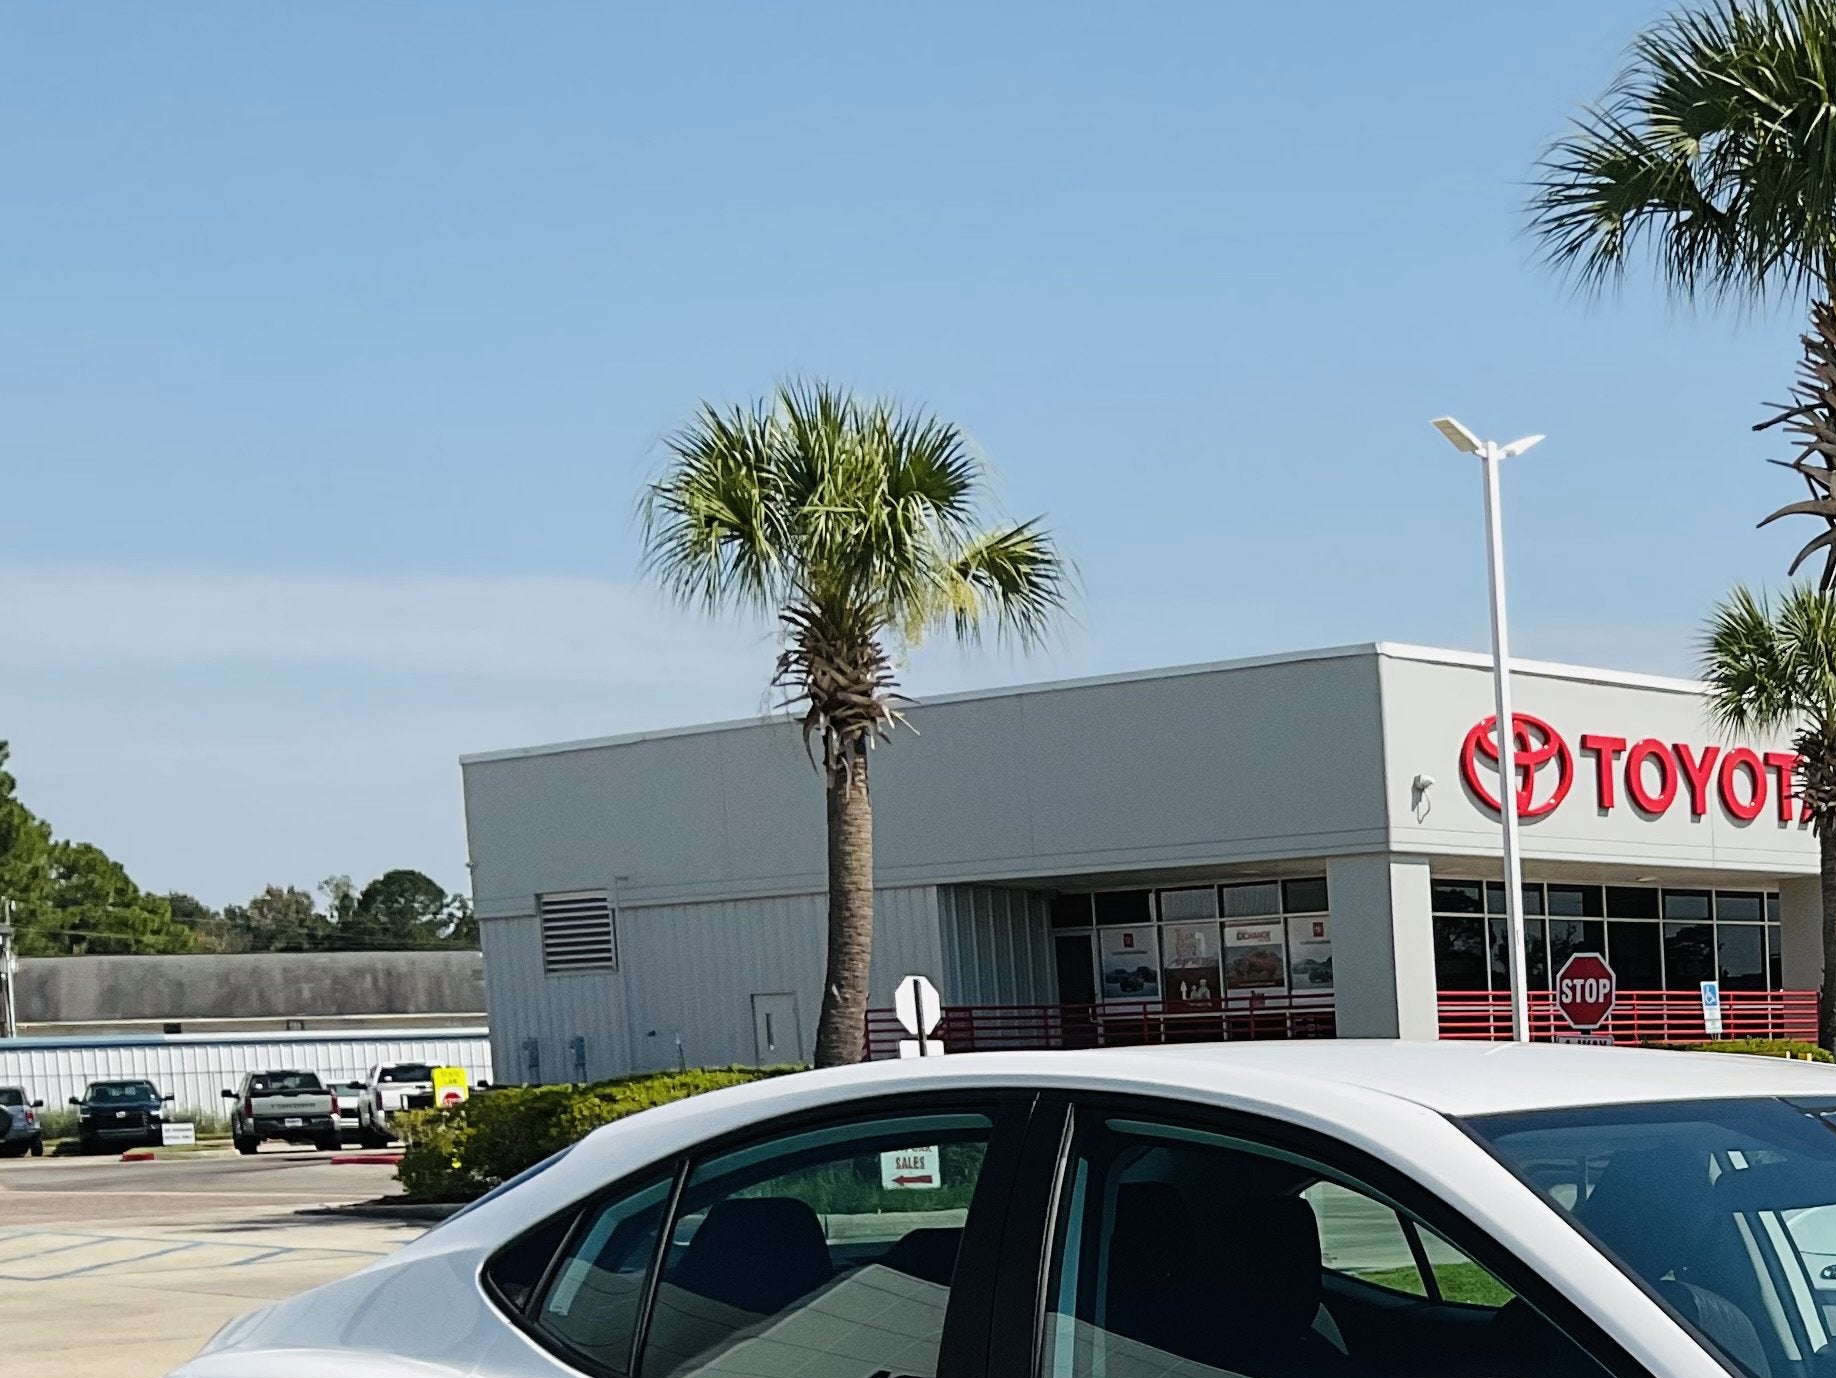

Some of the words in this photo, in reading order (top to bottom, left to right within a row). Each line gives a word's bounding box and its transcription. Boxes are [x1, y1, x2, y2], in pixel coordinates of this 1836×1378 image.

[1580, 734, 1816, 823] TOYOT
[1561, 978, 1611, 1004] STOP
[895, 1156, 926, 1170] SALES
